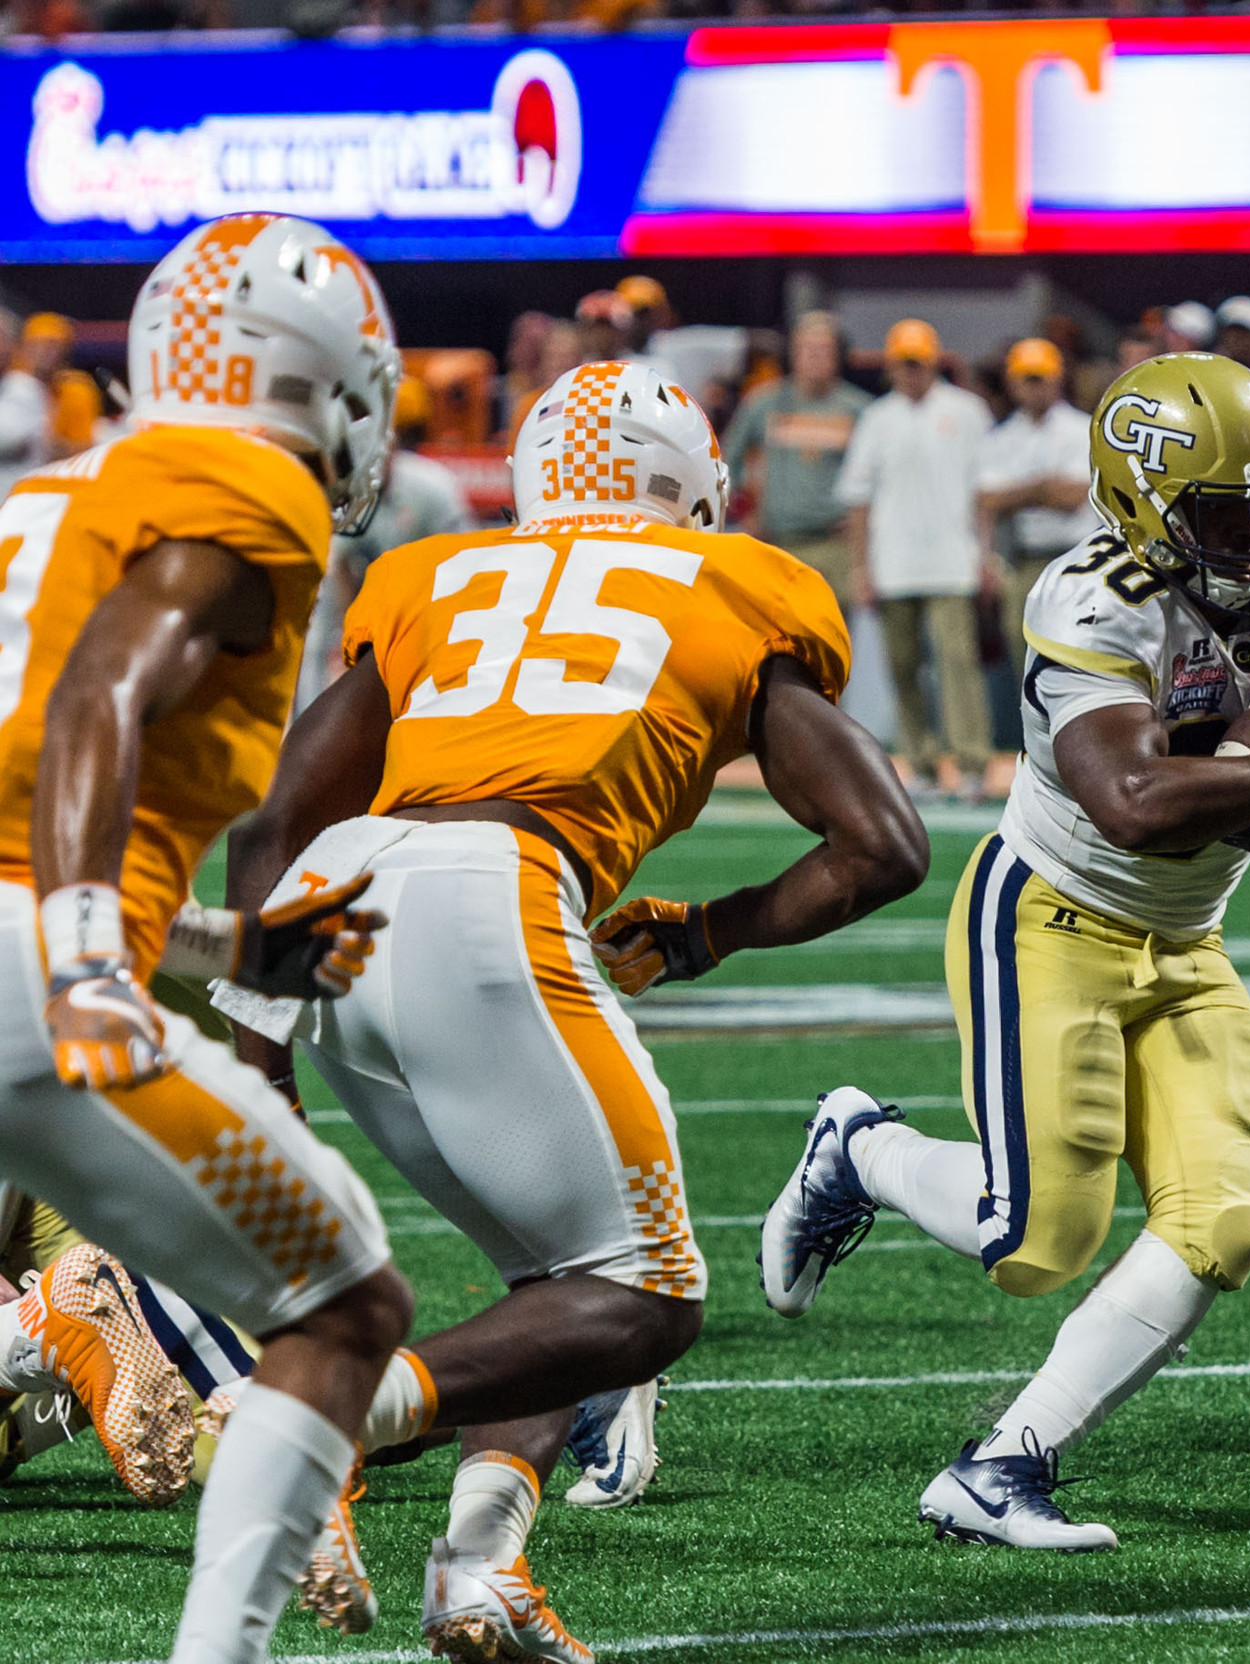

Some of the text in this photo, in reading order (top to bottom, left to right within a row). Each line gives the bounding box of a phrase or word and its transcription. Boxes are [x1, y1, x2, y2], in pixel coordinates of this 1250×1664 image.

[889, 19, 1110, 253] T
[1102, 393, 1196, 475] GT
[395, 539, 705, 722] 35
